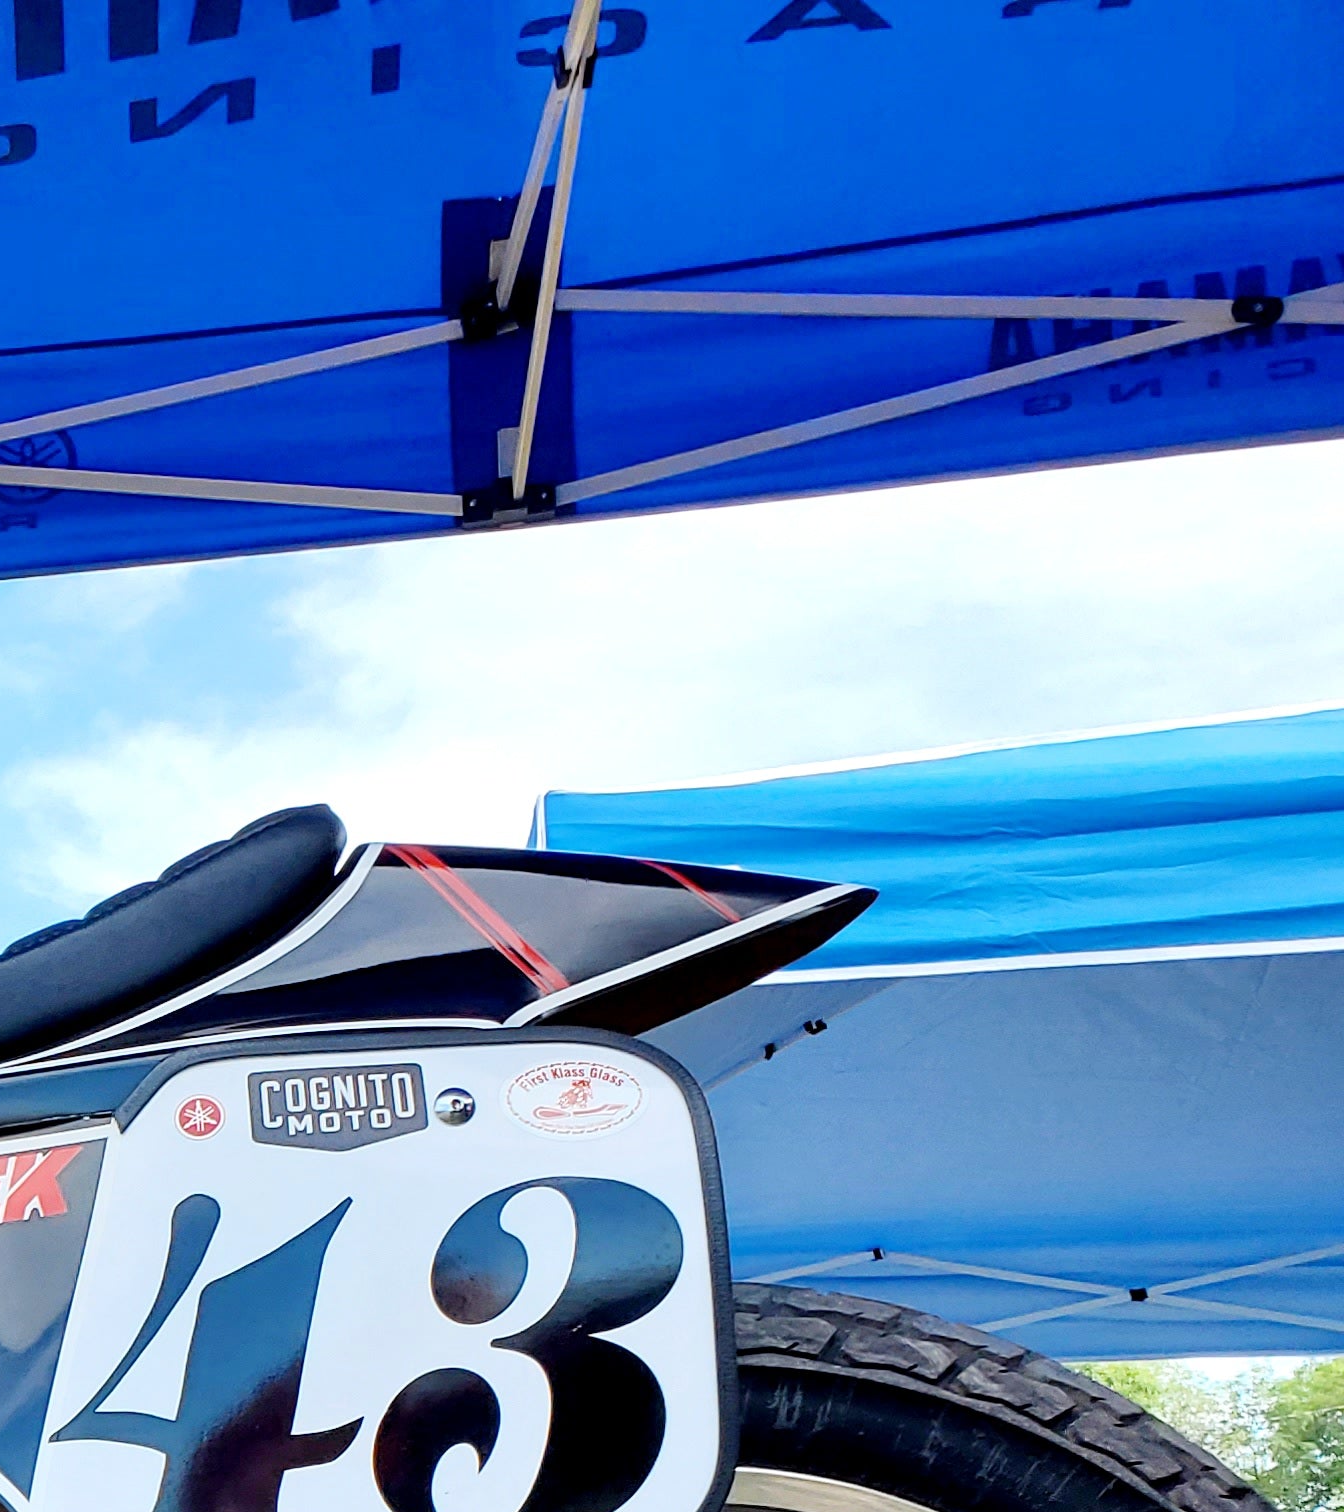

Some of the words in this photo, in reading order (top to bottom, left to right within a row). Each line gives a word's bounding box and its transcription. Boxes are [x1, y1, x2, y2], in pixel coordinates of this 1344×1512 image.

[519, 1072, 549, 1092] First
[551, 1068, 585, 1079] Klass
[589, 1067, 624, 1087] Glass
[259, 1072, 415, 1129] COGNITO
[287, 1107, 392, 1136] MOTO
